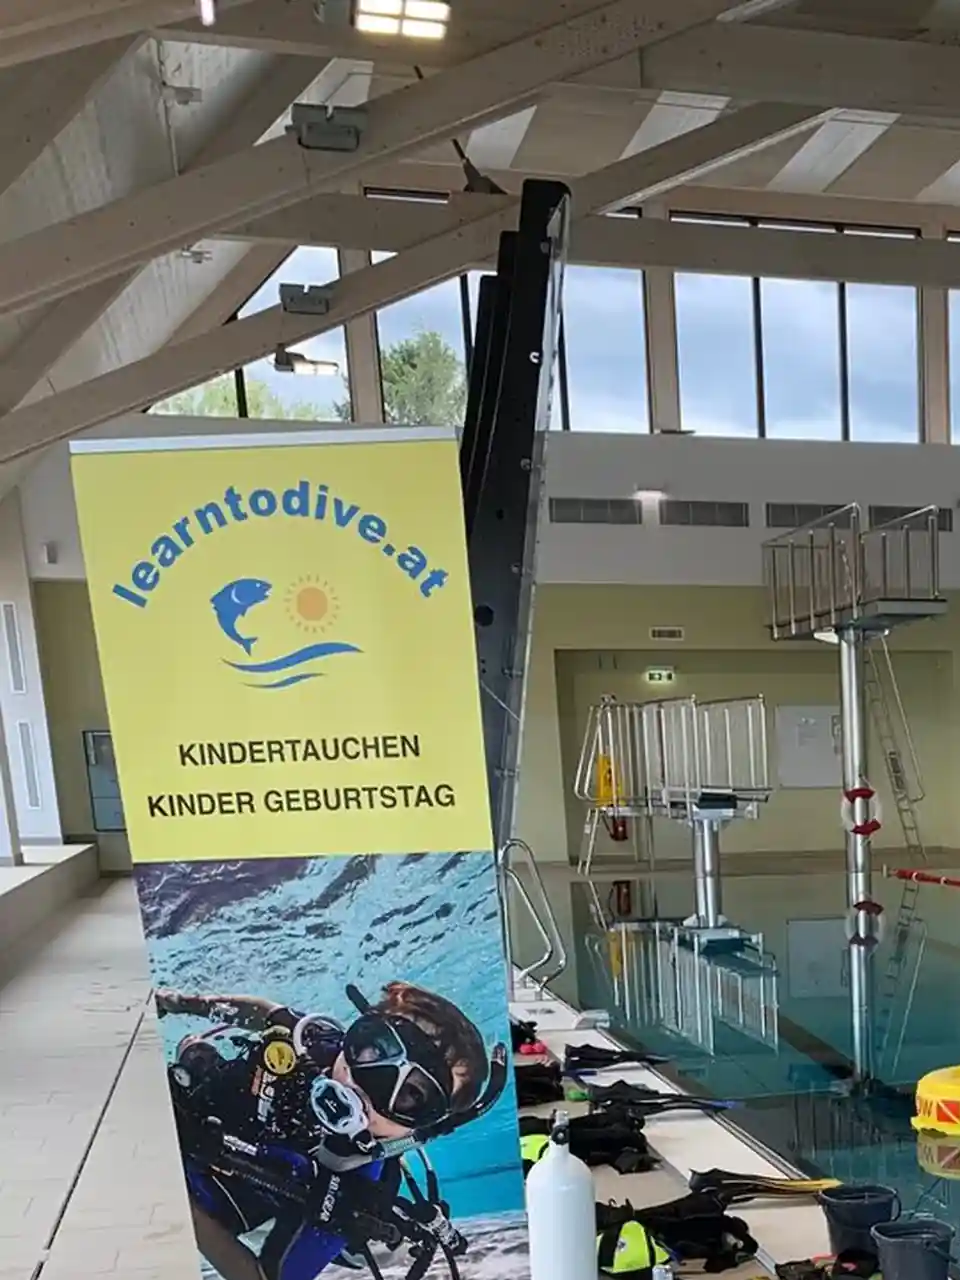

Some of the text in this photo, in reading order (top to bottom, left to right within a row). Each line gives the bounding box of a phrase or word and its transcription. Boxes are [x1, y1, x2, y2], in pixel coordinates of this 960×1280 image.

[112, 480, 450, 609] learntodive.at
[178, 734, 421, 767] KINDERTAUCHEN
[147, 784, 456, 818] KINDER GEBURTSTAG
